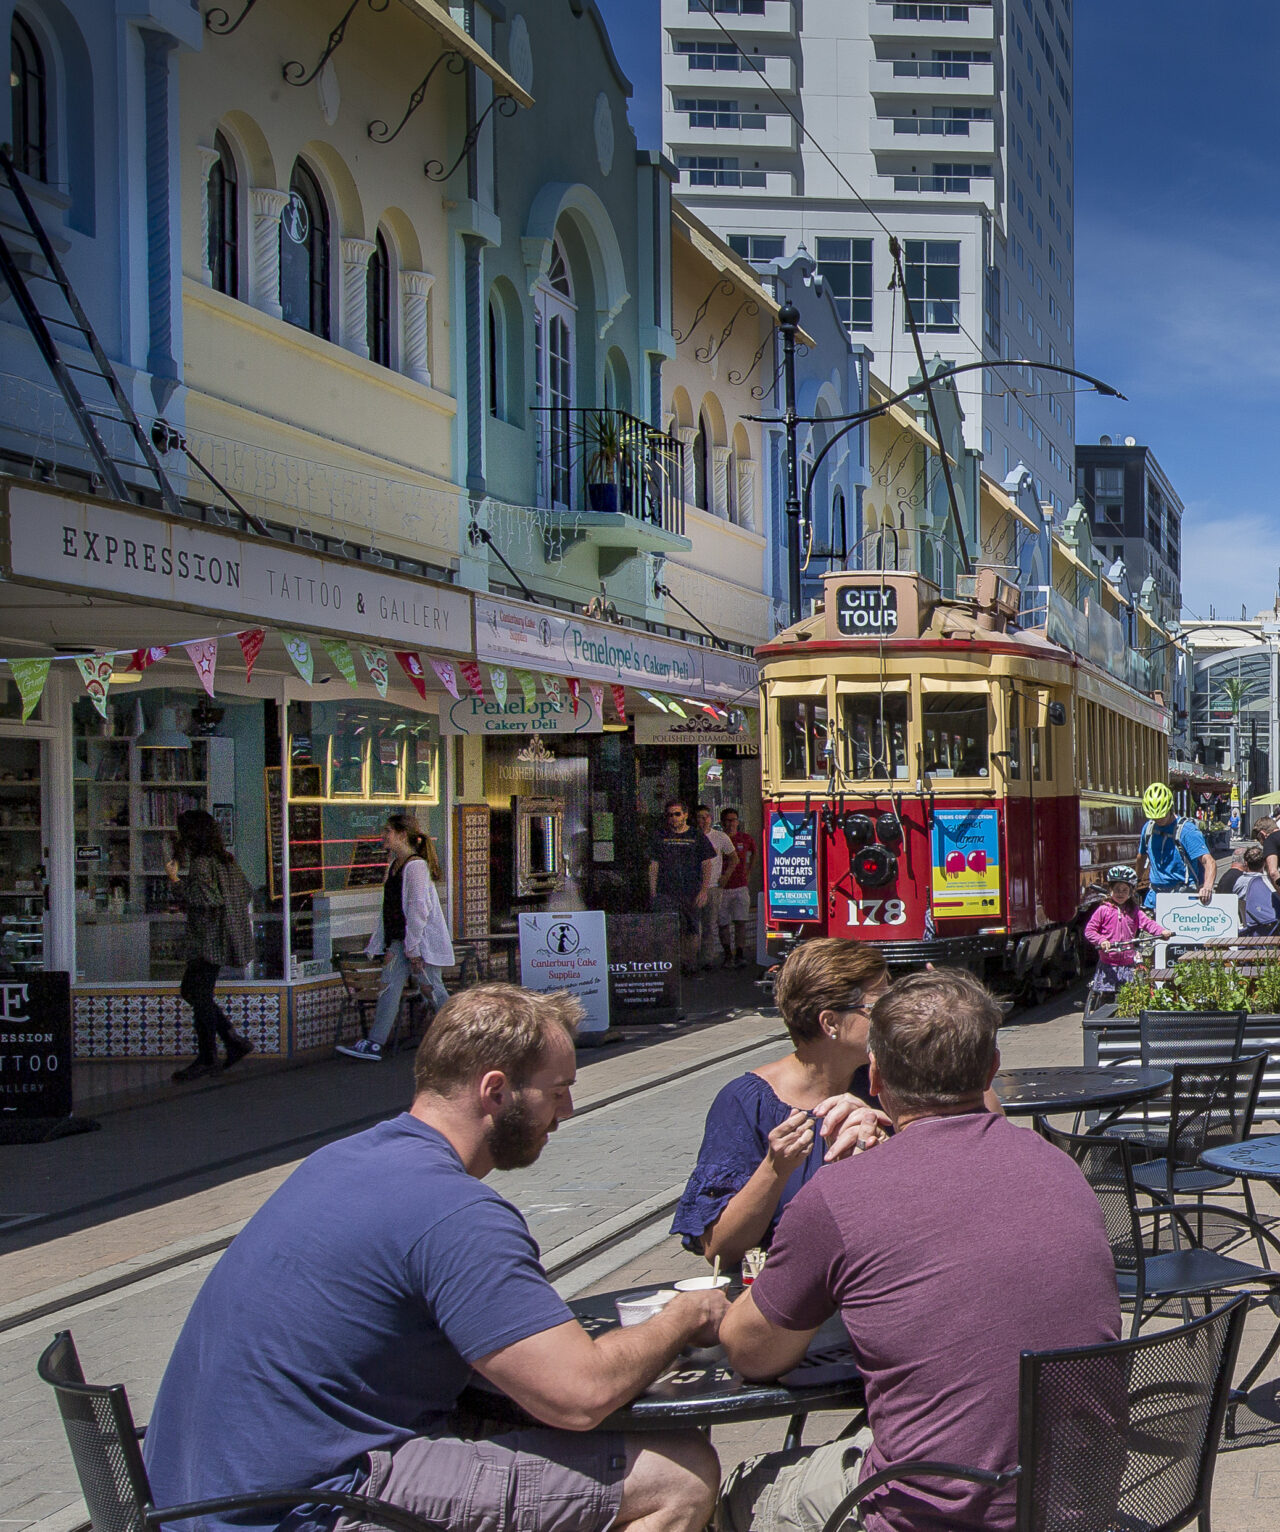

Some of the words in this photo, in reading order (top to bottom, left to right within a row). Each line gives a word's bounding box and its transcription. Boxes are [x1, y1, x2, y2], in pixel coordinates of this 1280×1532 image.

[62, 526, 240, 589] EXPRESSION
[266, 569, 342, 610] TATTOO
[356, 592, 365, 615] &
[379, 595, 449, 632] GALLERY
[845, 590, 891, 607] CITY
[841, 610, 897, 627] TOUR
[571, 629, 641, 678] Penelope's
[643, 654, 672, 683] Cakery
[672, 660, 689, 681] Deli
[470, 695, 579, 720] Penelope's
[485, 719, 528, 733] Cakery
[531, 719, 557, 730] Deli
[652, 735, 694, 743] POLISHED
[699, 734, 747, 743] DIAMONDS
[774, 857, 791, 866] NOW
[791, 857, 810, 866] OPEN
[772, 866, 780, 876] AT
[781, 866, 795, 876] THE
[795, 866, 813, 876] ARTS
[779, 876, 806, 885] CENTRE
[846, 899, 907, 926] 178
[1172, 913, 1226, 926] Penelope's
[1178, 925, 1200, 933] Cakery
[531, 958, 576, 969] Canterbury
[577, 957, 597, 967] Cake
[548, 969, 581, 981] Supplies
